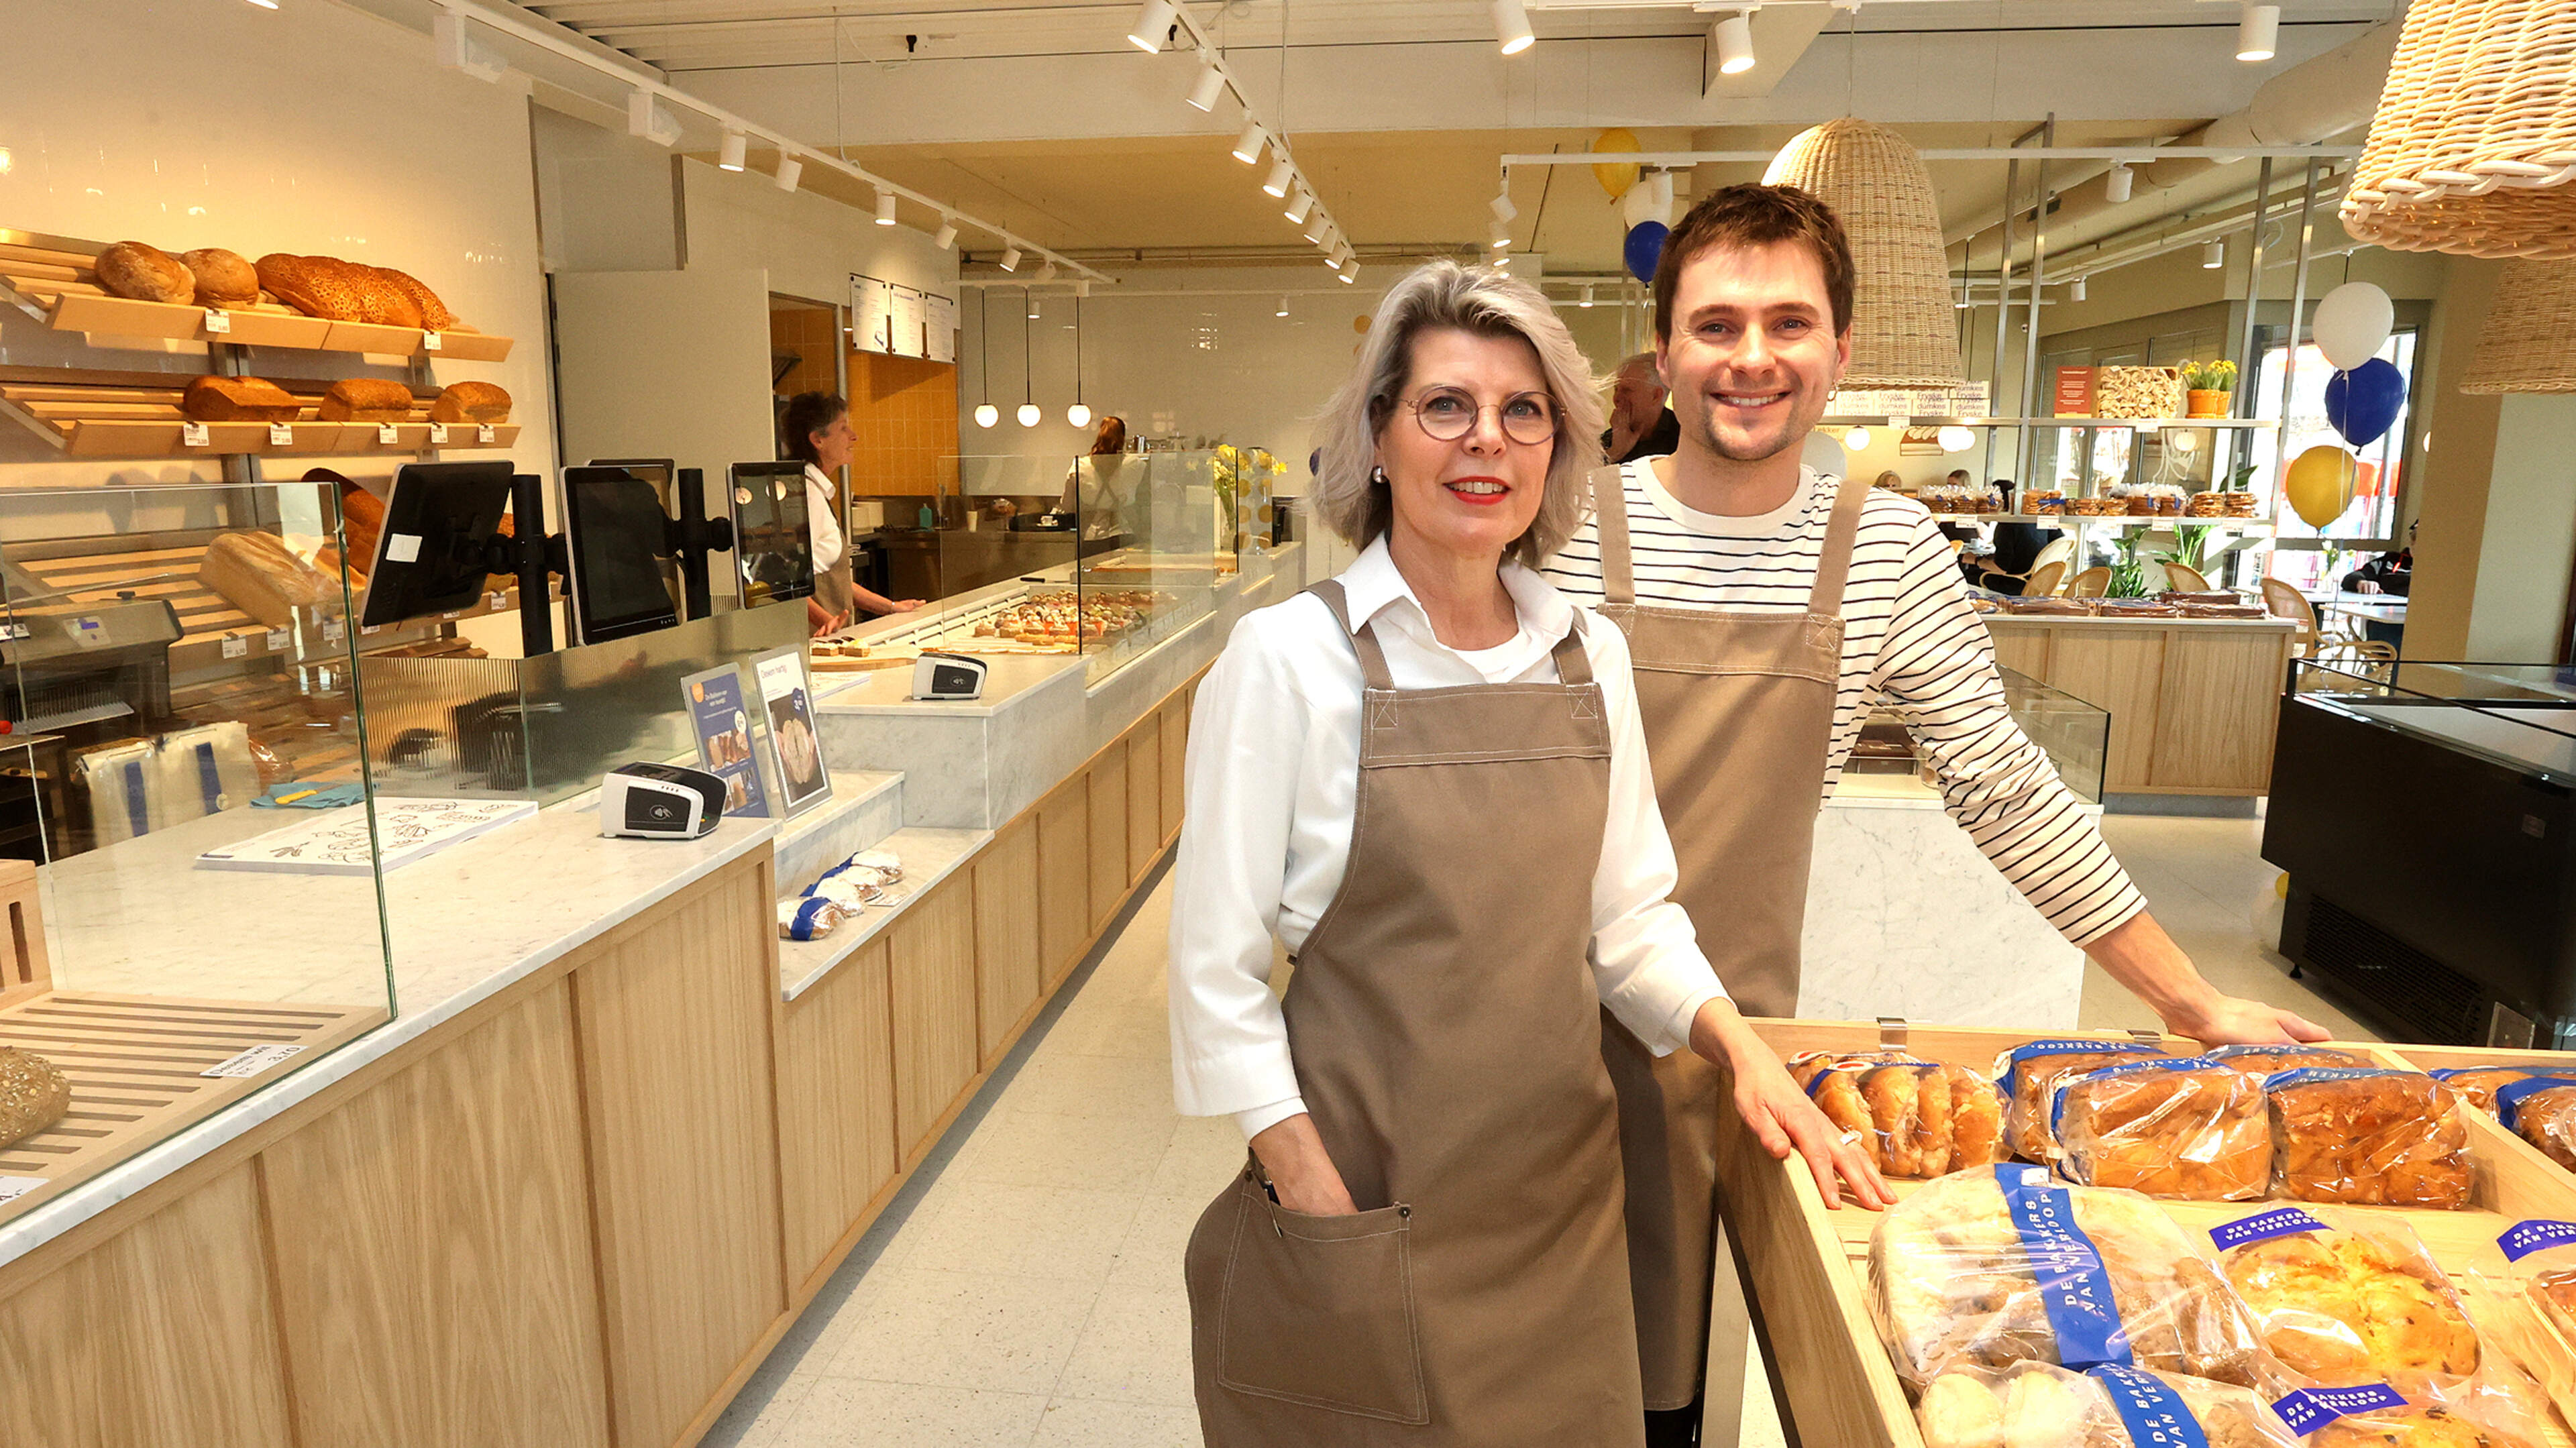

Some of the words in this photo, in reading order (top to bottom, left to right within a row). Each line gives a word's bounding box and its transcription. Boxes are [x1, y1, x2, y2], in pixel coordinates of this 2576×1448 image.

[2025, 1201, 2067, 1274] BAKKERS
[2040, 1194, 2082, 1266] VERLOOP
[2225, 1229, 2252, 1241] VAN
[2226, 1225, 2244, 1234] DE
[2513, 1228, 2531, 1240] DE
[2514, 1234, 2542, 1248] VAN
[2060, 1280, 2078, 1306] DE
[2076, 1272, 2096, 1312] VAN
[2098, 1363, 2151, 1408] BAKKER
[2286, 1402, 2305, 1416] DE
[2288, 1408, 2316, 1427] VAN
[2145, 1418, 2167, 1443] DE
[2159, 1413, 2188, 1448] VAN
